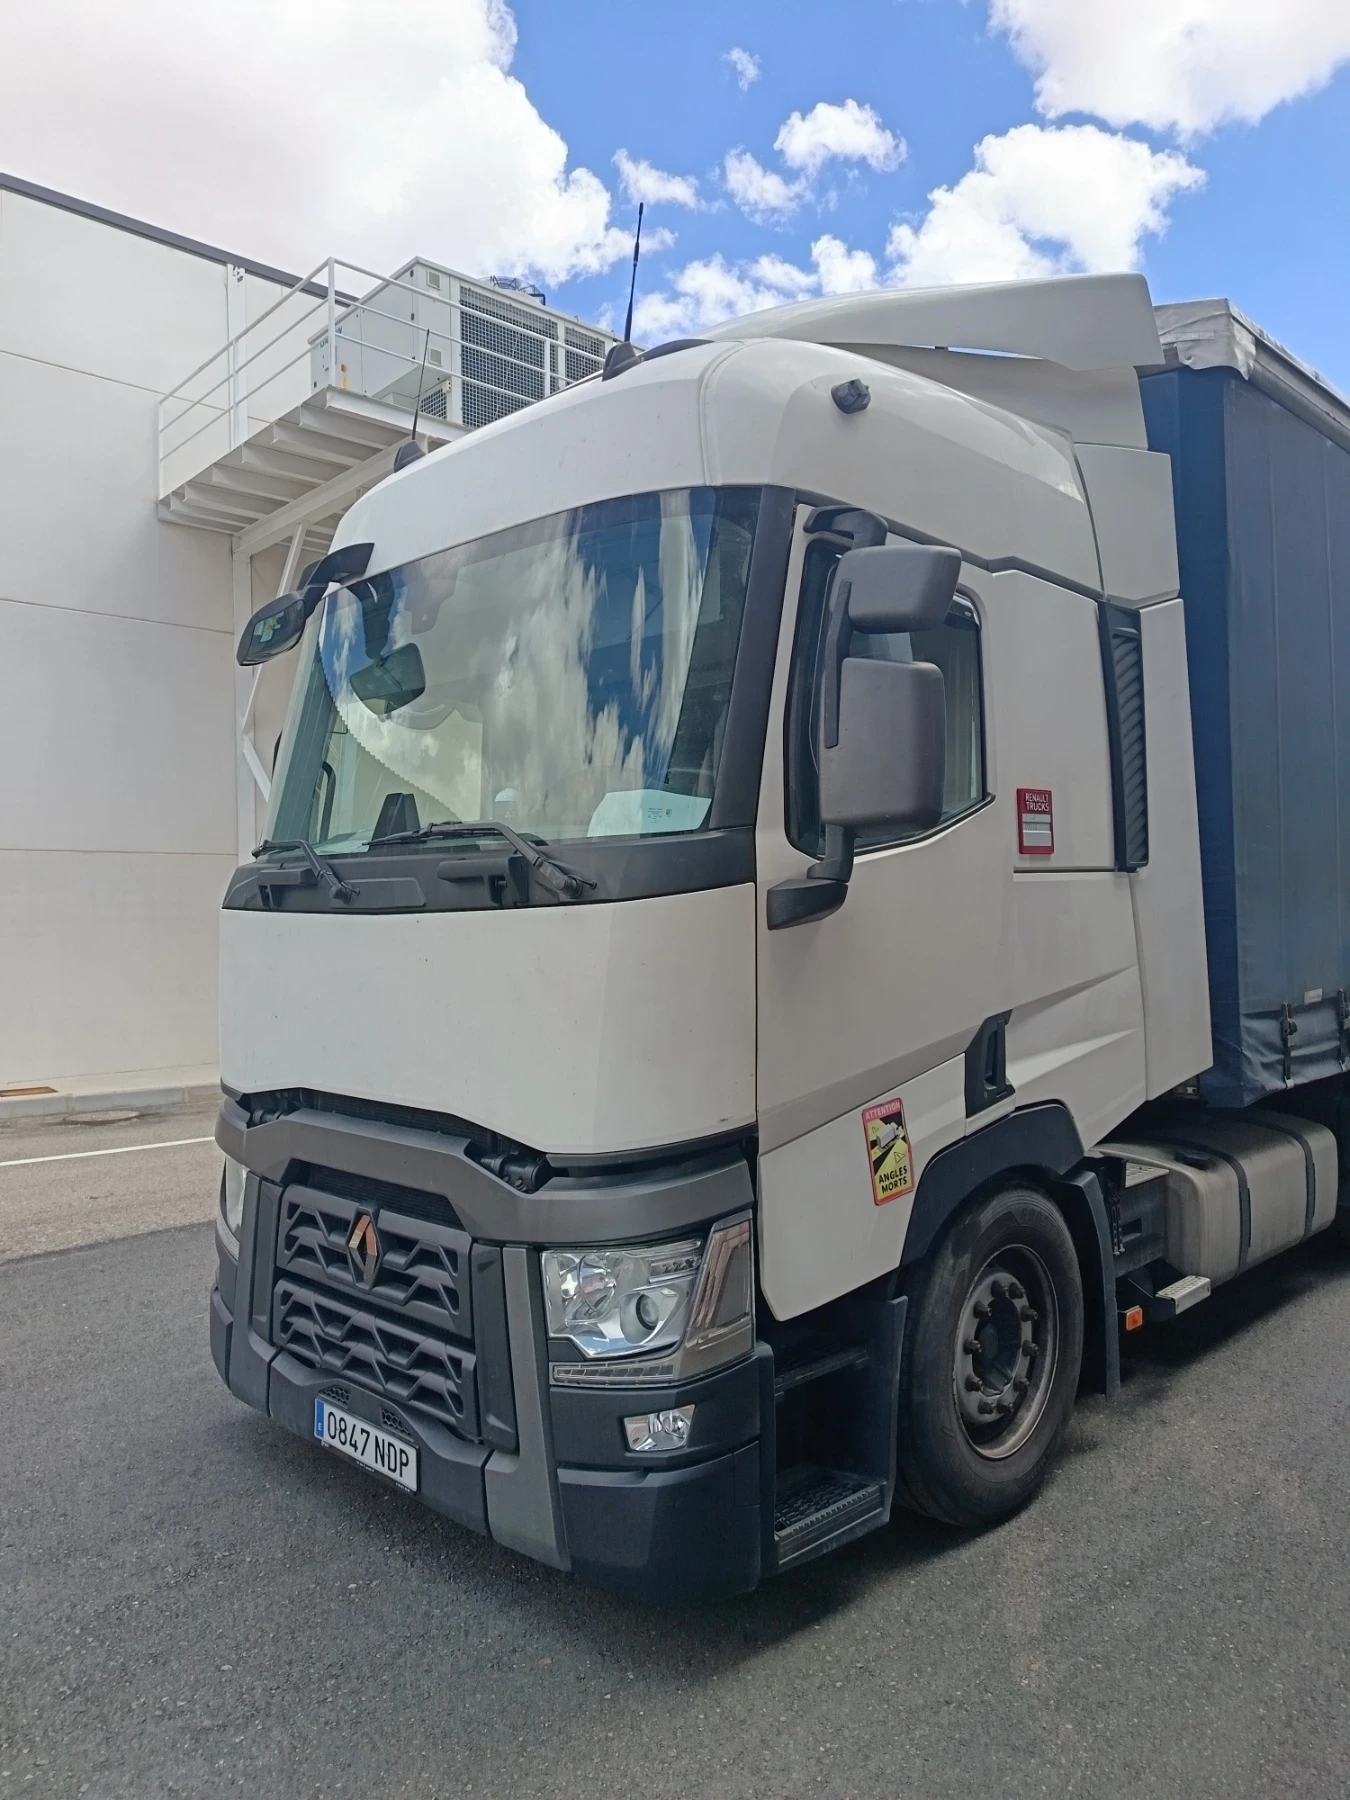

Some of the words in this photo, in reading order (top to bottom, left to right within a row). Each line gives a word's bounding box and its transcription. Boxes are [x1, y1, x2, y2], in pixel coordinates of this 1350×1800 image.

[1025, 793, 1049, 803] RENAULT
[1026, 802, 1049, 811] TRUCKS
[865, 1100, 901, 1120] ATTENTION
[879, 1165, 908, 1184] ANGLES
[881, 1176, 908, 1194] MORTS
[327, 1411, 371, 1456] 0847
[375, 1435, 410, 1478] NDP
